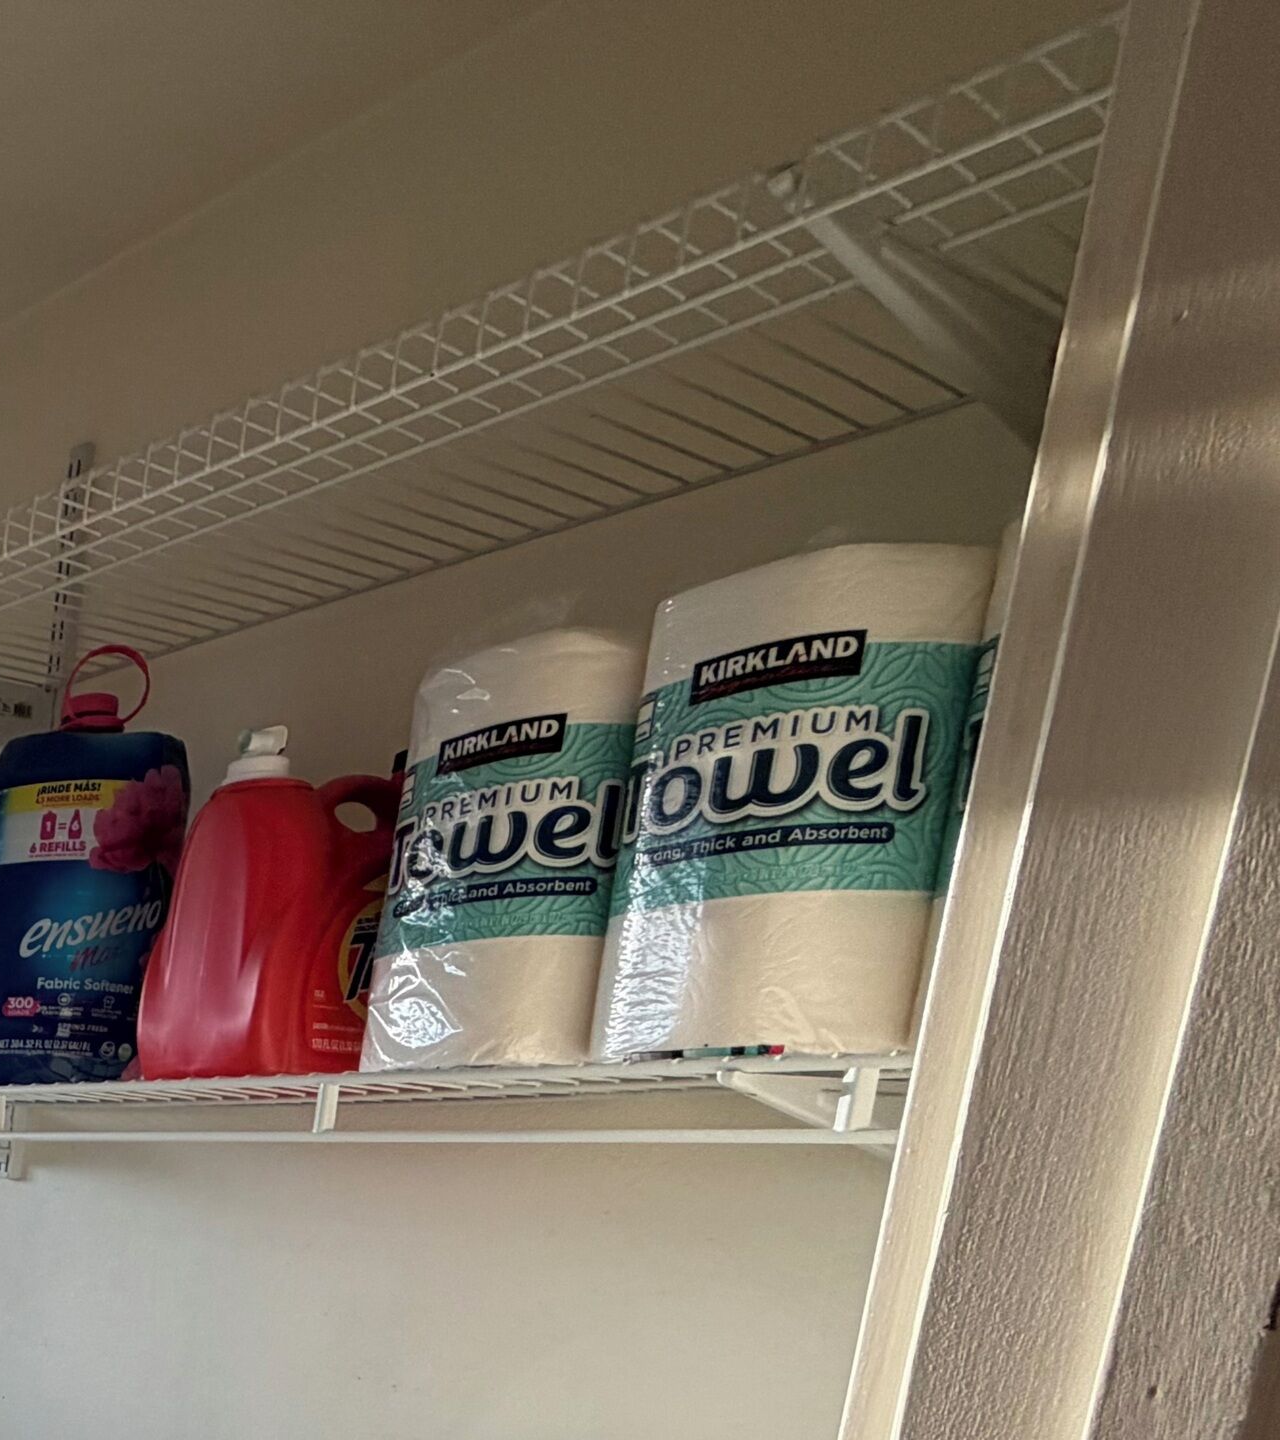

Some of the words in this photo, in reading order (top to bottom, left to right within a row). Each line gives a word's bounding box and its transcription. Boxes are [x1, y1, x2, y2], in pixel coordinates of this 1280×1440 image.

[698, 635, 858, 686] KIRKLAND
[442, 718, 559, 761] KIRKLAND
[673, 709, 872, 760] PREMIUM
[425, 780, 573, 822] PREMIUM
[29, 842, 36, 853] 6
[39, 841, 86, 852] REFILLS
[691, 835, 736, 855] Thick
[741, 825, 780, 847] and
[787, 822, 888, 842] Absorbent
[469, 881, 498, 899] and
[502, 878, 591, 894] Absorbent
[36, 976, 80, 989] Fabric
[83, 978, 133, 994] Softener
[7, 996, 33, 1008] 300
